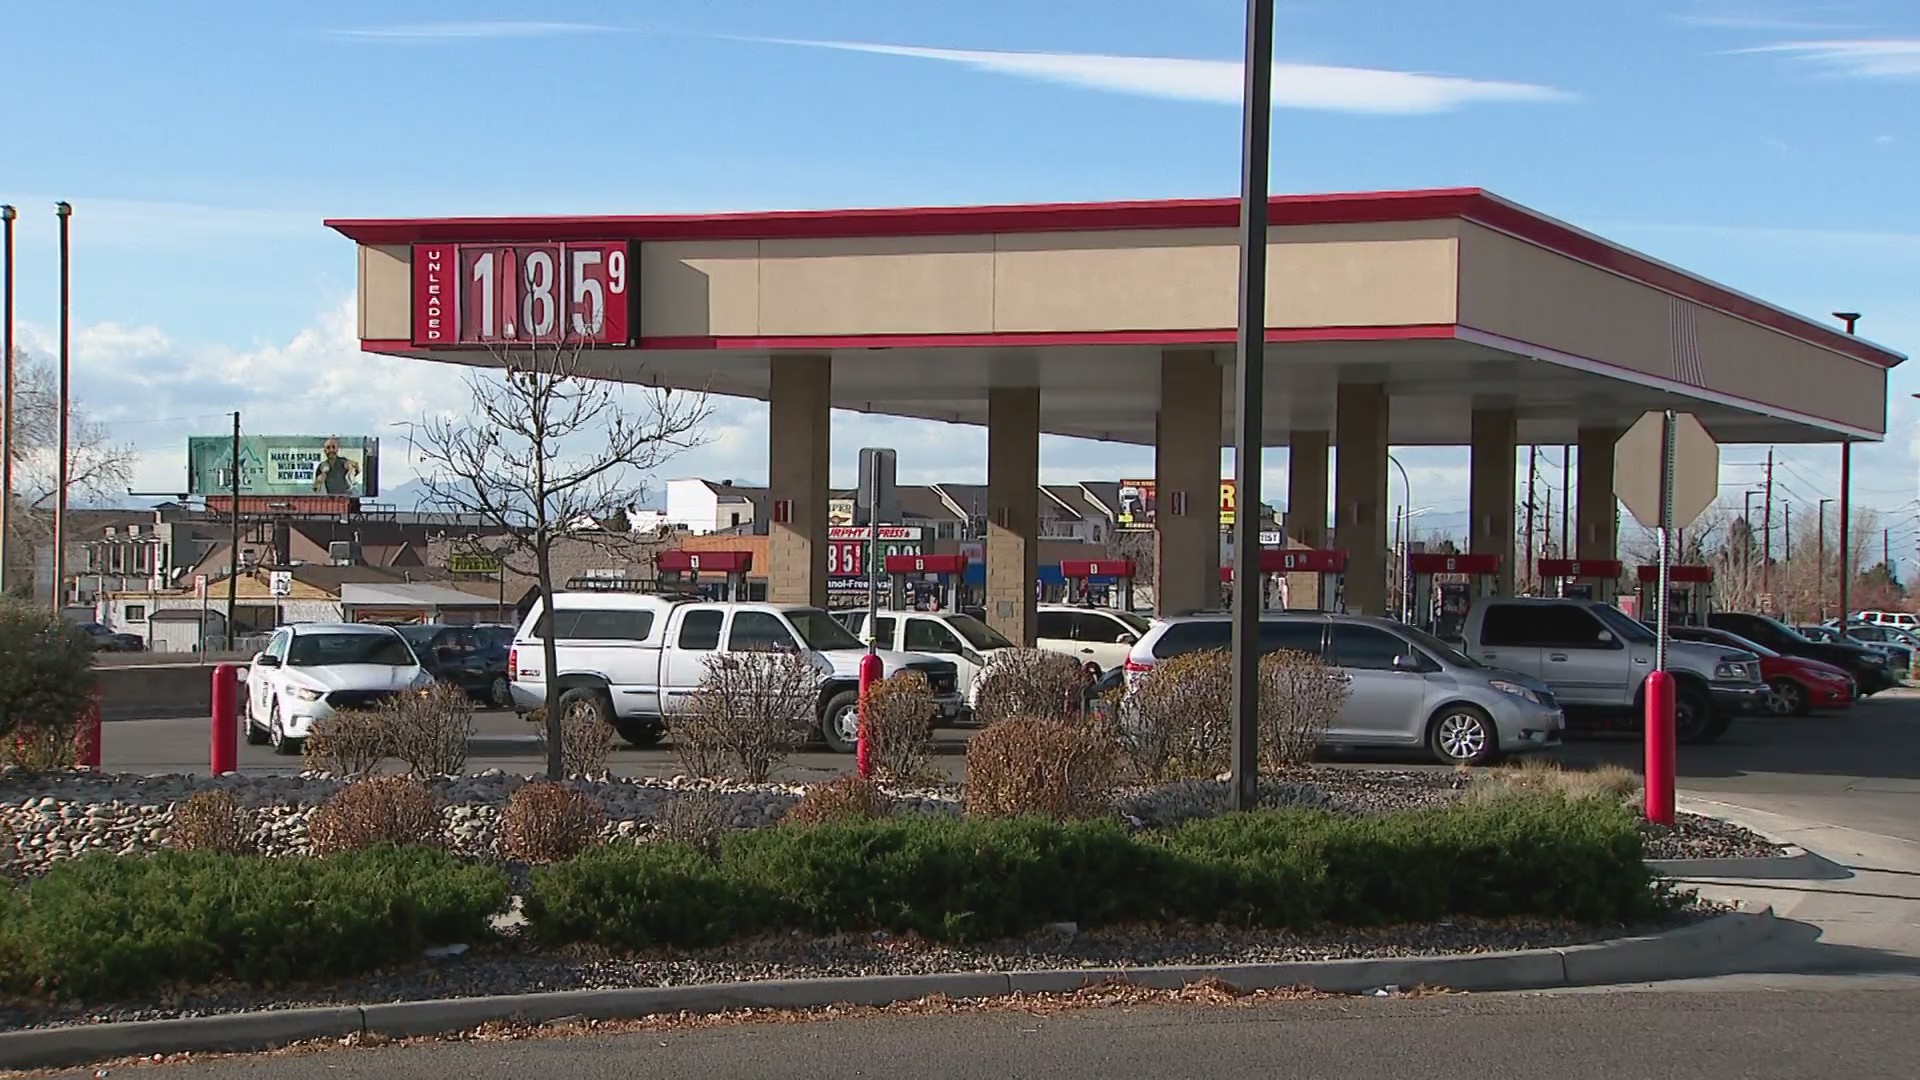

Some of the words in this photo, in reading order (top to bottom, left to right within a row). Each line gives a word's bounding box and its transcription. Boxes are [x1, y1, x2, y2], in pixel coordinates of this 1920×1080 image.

[428, 251, 441, 339] UNLEADED
[271, 453, 290, 462] MAKE
[297, 453, 321, 462] SPLASH
[278, 471, 293, 480] NEW
